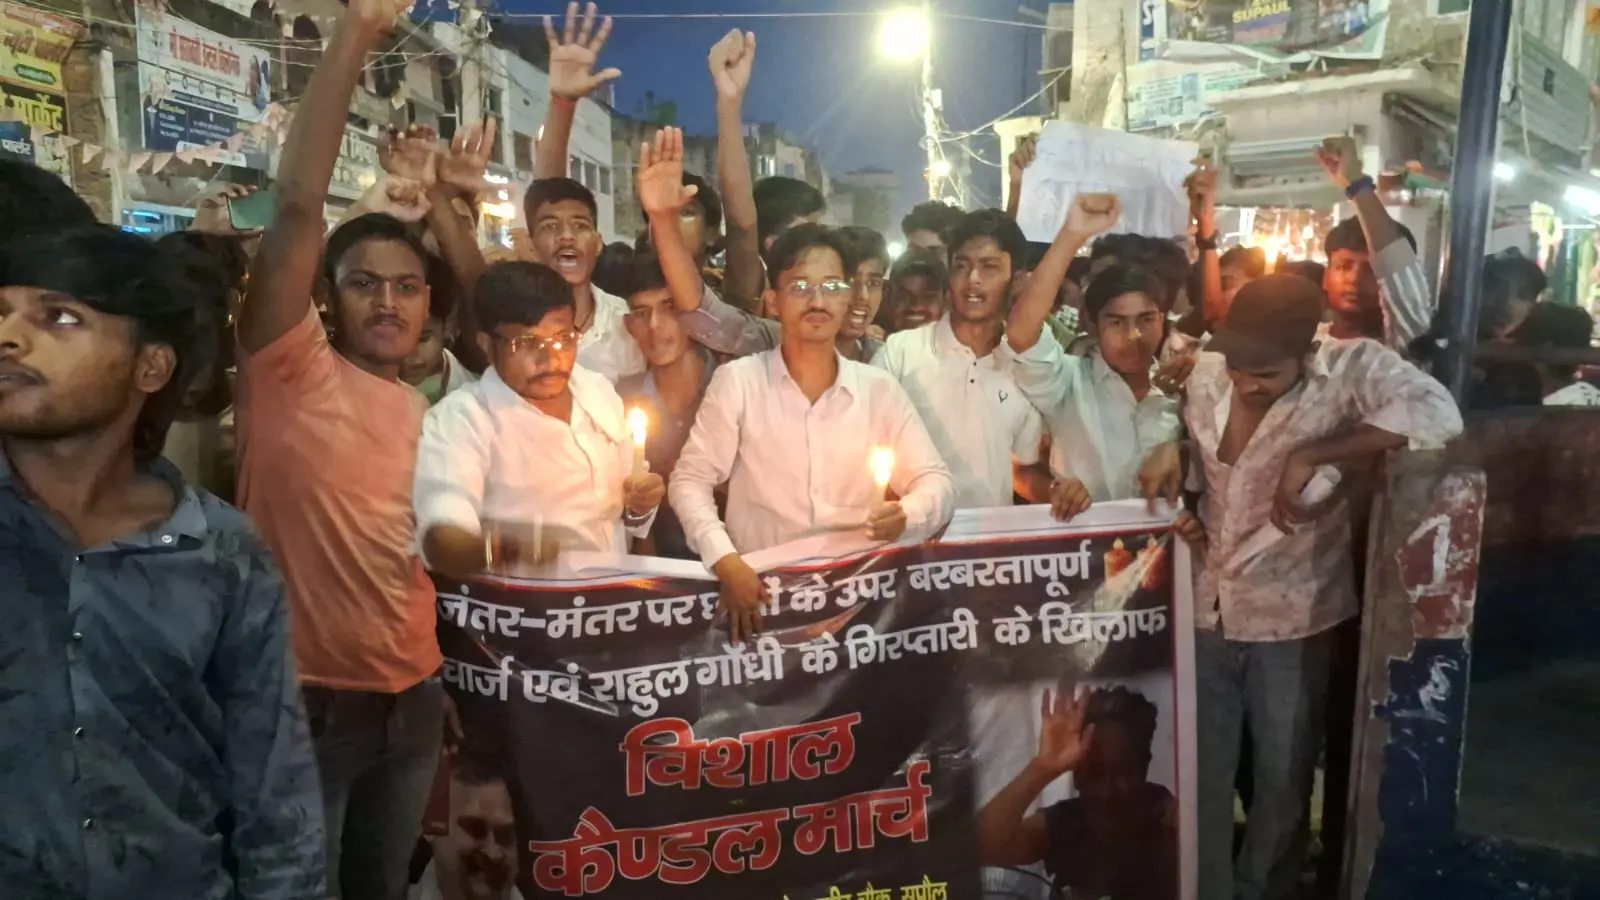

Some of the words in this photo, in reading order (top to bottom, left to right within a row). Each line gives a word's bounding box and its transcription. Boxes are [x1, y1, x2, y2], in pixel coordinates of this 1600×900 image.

[1232, 1, 1291, 24] SUPAUL
[645, 595, 697, 626] पर
[790, 573, 828, 613] के
[835, 568, 898, 608] उपर
[907, 539, 1091, 597] बरबरतापूर्ण
[521, 662, 582, 703] एवं
[588, 660, 690, 717] राहुल
[800, 631, 840, 674] के
[845, 607, 979, 670] गिरप्तारी
[992, 605, 1034, 646] के
[1037, 601, 1168, 645] खिलाफ
[619, 712, 861, 797] विशाल
[529, 806, 789, 897] कैण्डल
[793, 760, 932, 855] मार्च
